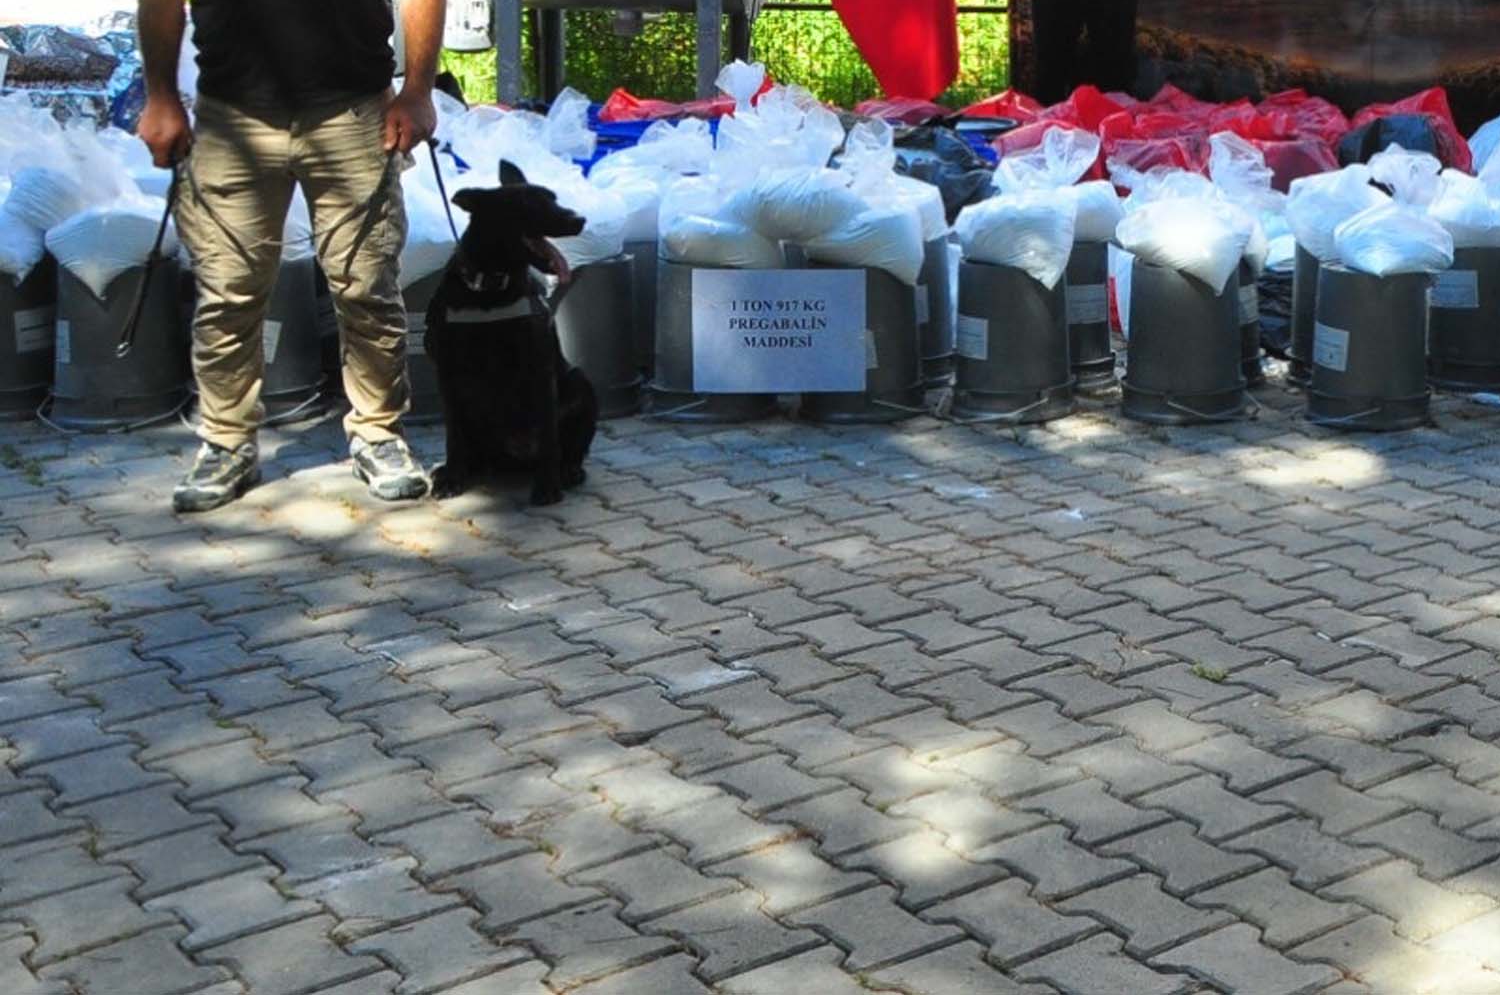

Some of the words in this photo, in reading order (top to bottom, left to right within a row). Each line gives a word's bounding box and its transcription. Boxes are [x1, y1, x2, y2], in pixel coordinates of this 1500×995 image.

[741, 300, 773, 312] TON
[776, 300, 799, 312] 917
[803, 300, 826, 312] KG
[729, 316, 827, 330] PREGABALİN
[744, 334, 813, 348] MADDESİ
